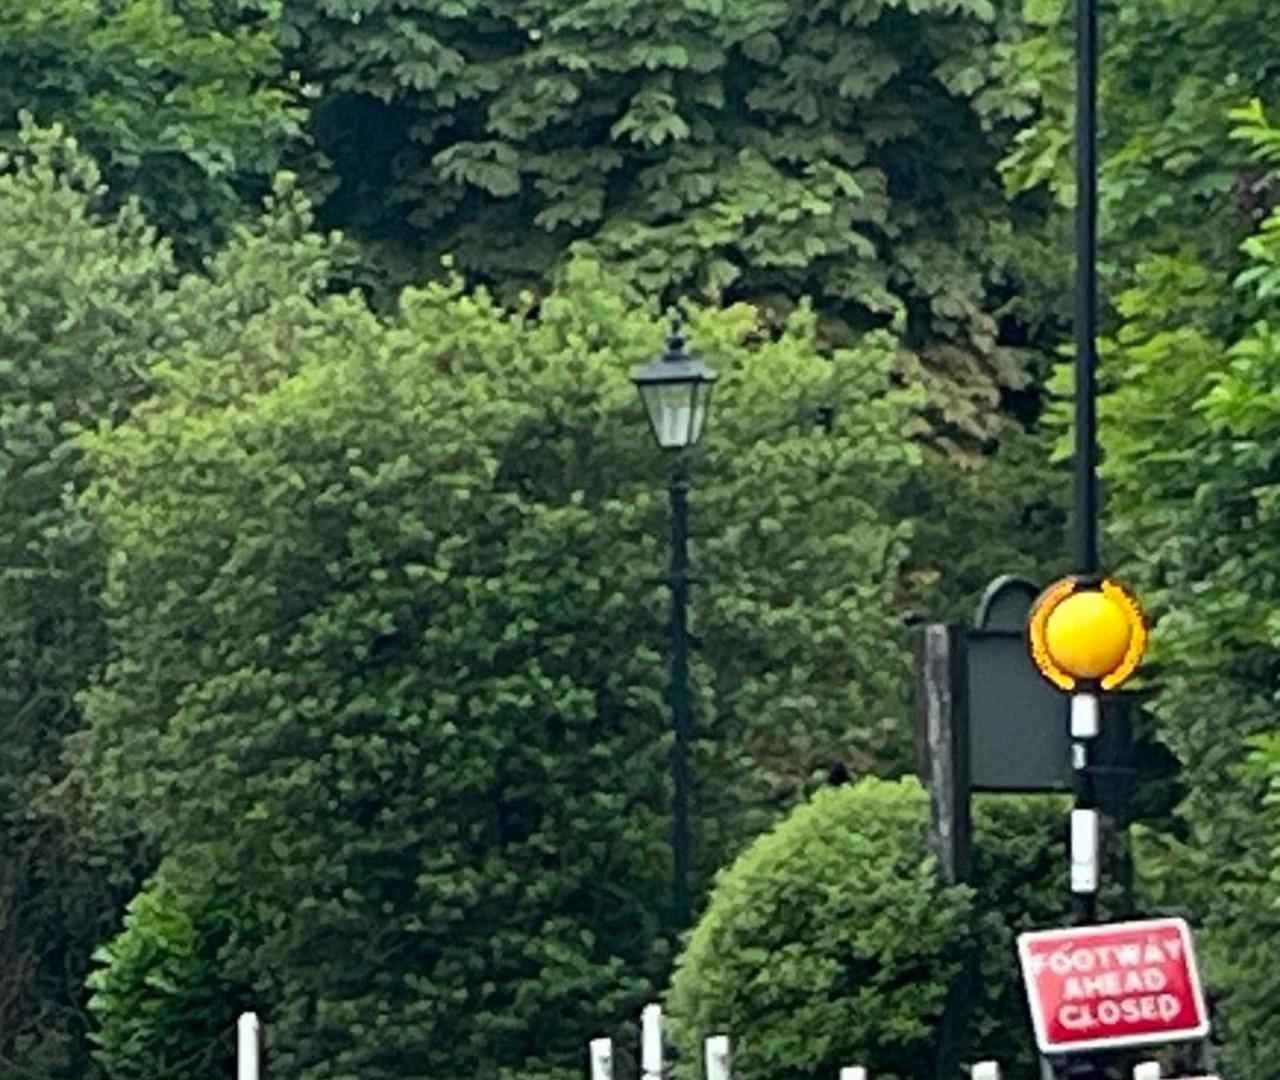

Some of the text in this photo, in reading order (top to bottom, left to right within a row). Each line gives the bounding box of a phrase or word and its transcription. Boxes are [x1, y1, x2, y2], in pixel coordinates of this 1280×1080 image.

[1029, 939, 1182, 976] FOOTWAY
[1062, 966, 1168, 1000] AHEAD
[1059, 993, 1182, 1031] CLOSED
